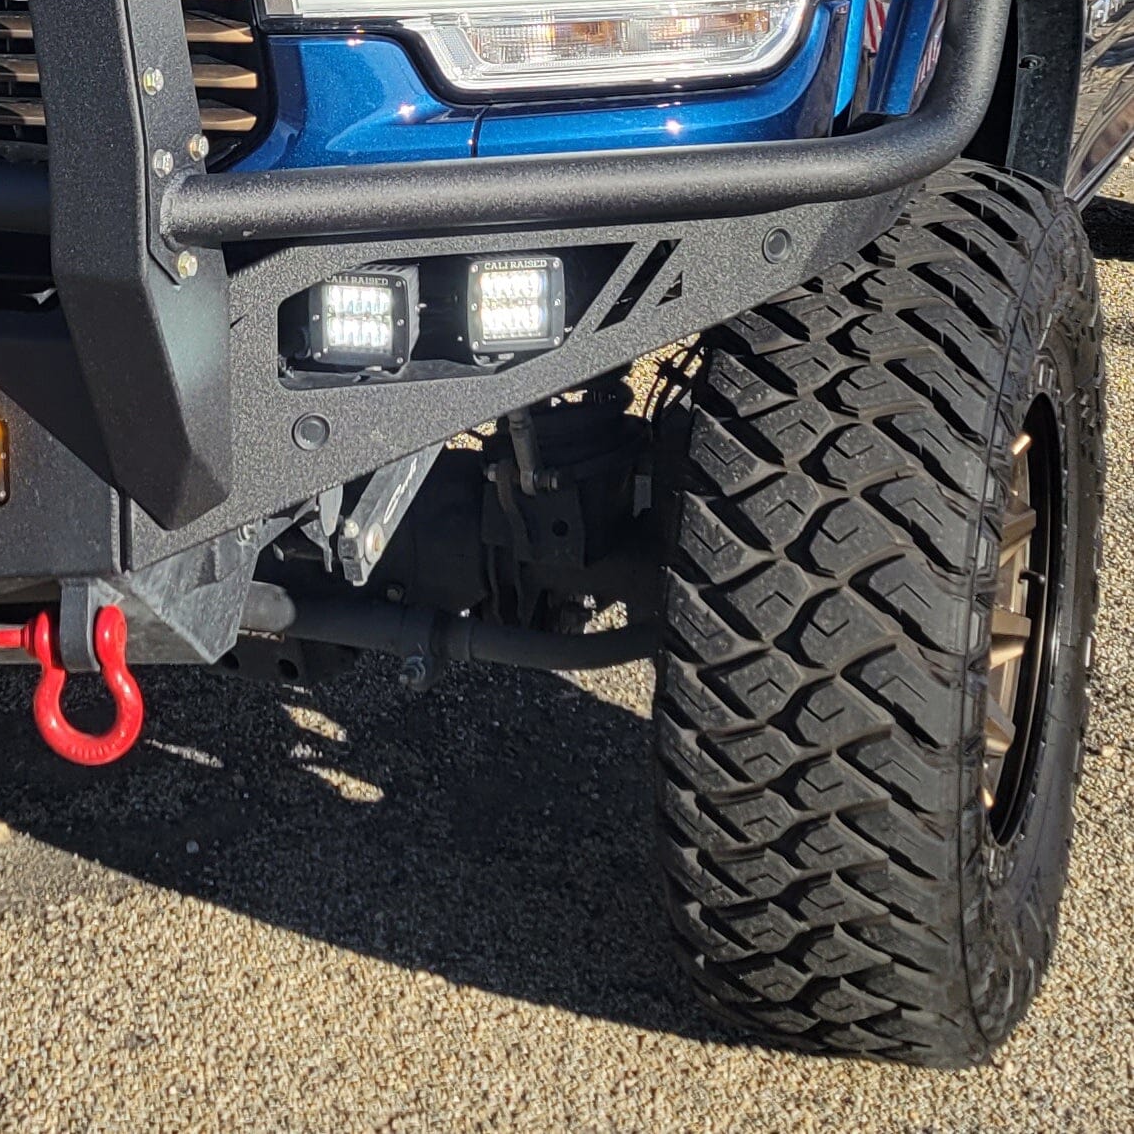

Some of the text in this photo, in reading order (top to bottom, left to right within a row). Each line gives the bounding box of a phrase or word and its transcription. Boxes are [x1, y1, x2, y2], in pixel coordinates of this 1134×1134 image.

[484, 259, 548, 270] CALI RAISED
[351, 276, 389, 286] RAISED
